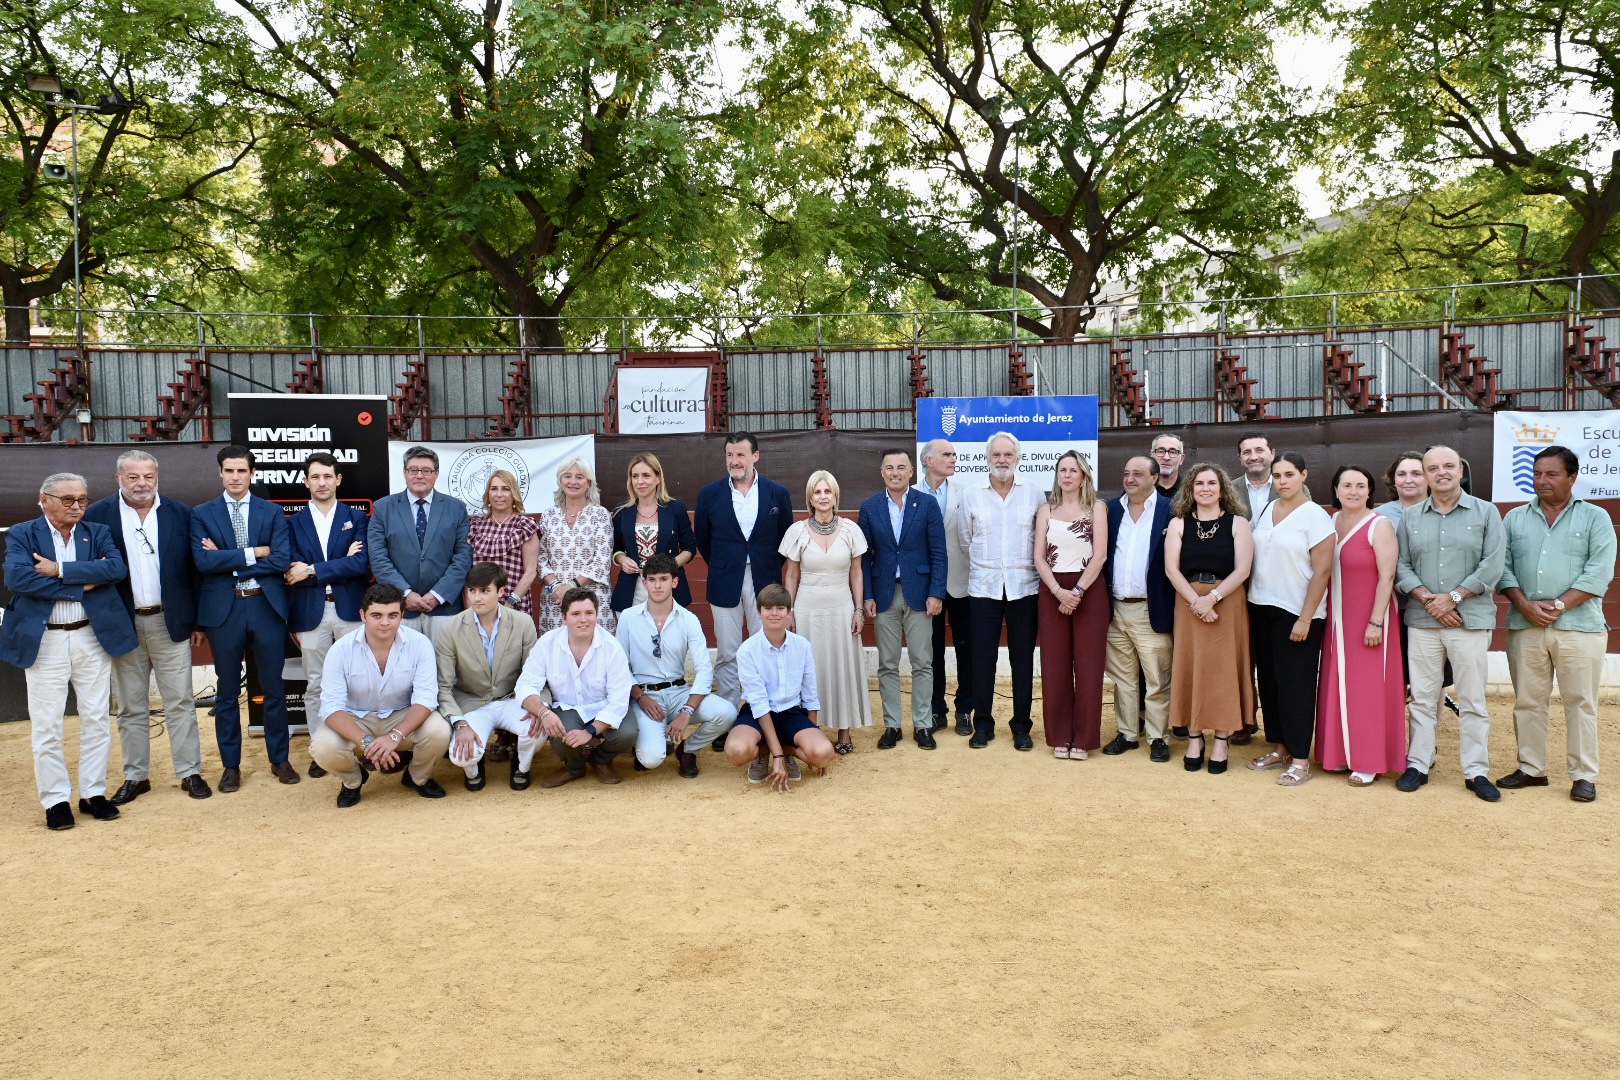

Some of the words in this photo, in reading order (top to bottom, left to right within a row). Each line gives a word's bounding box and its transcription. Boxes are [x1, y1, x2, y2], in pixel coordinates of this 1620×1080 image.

[959, 414, 1030, 426] Ayuntamiento
[1032, 414, 1045, 423] de
[1047, 413, 1073, 424] Jerez
[1583, 427, 1620, 440] Escu
[960, 453, 971, 461] DE
[1589, 445, 1611, 459] de
[452, 452, 474, 484] TAURINA
[476, 447, 514, 459] COLEGIO
[1580, 464, 1598, 475] de
[1603, 464, 1620, 475] Je
[250, 470, 306, 484] PRIVA
[1590, 487, 1620, 496] #Fun
